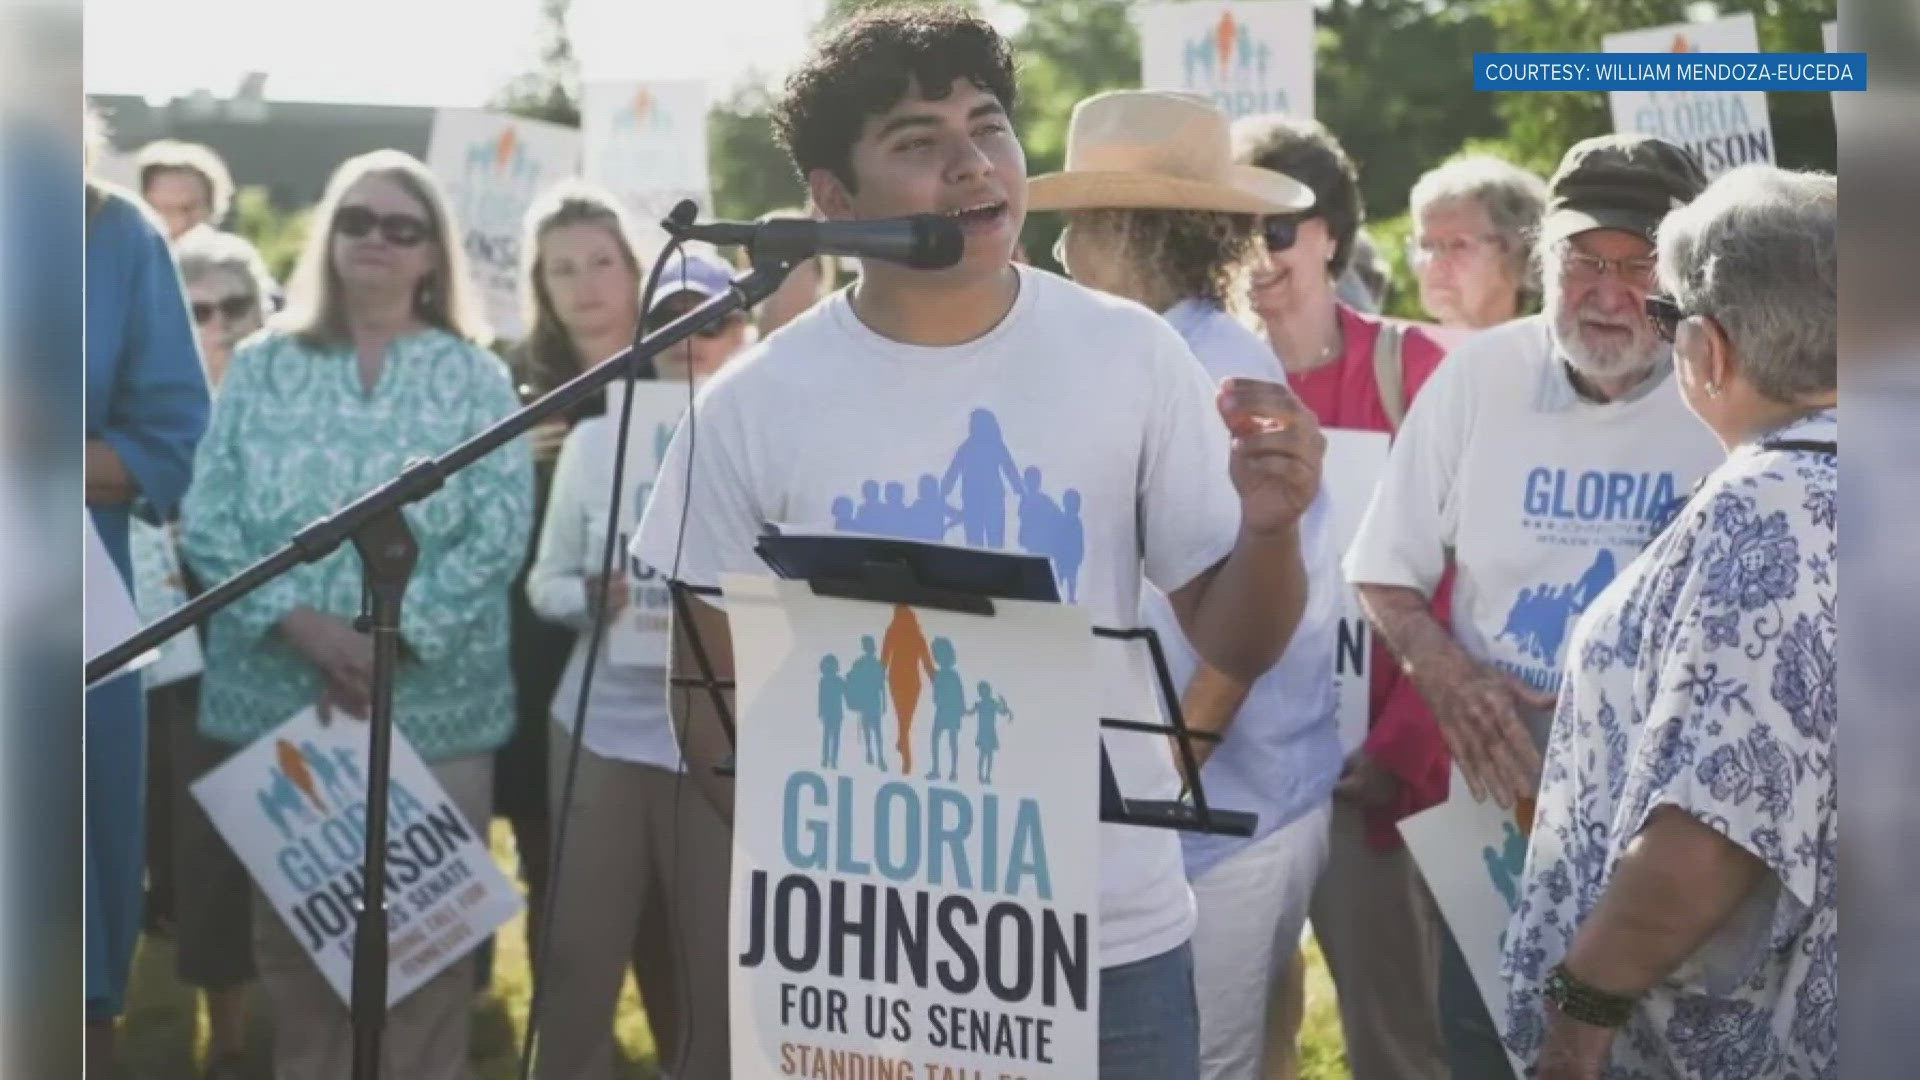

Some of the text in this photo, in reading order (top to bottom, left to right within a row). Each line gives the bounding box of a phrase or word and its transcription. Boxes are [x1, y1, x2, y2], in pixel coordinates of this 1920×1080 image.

[1523, 466, 1676, 523] GLORIA
[782, 770, 1052, 900] GLORIA
[739, 870, 1088, 1012] JOHNSON
[780, 982, 1053, 1064] FOR US SENATE
